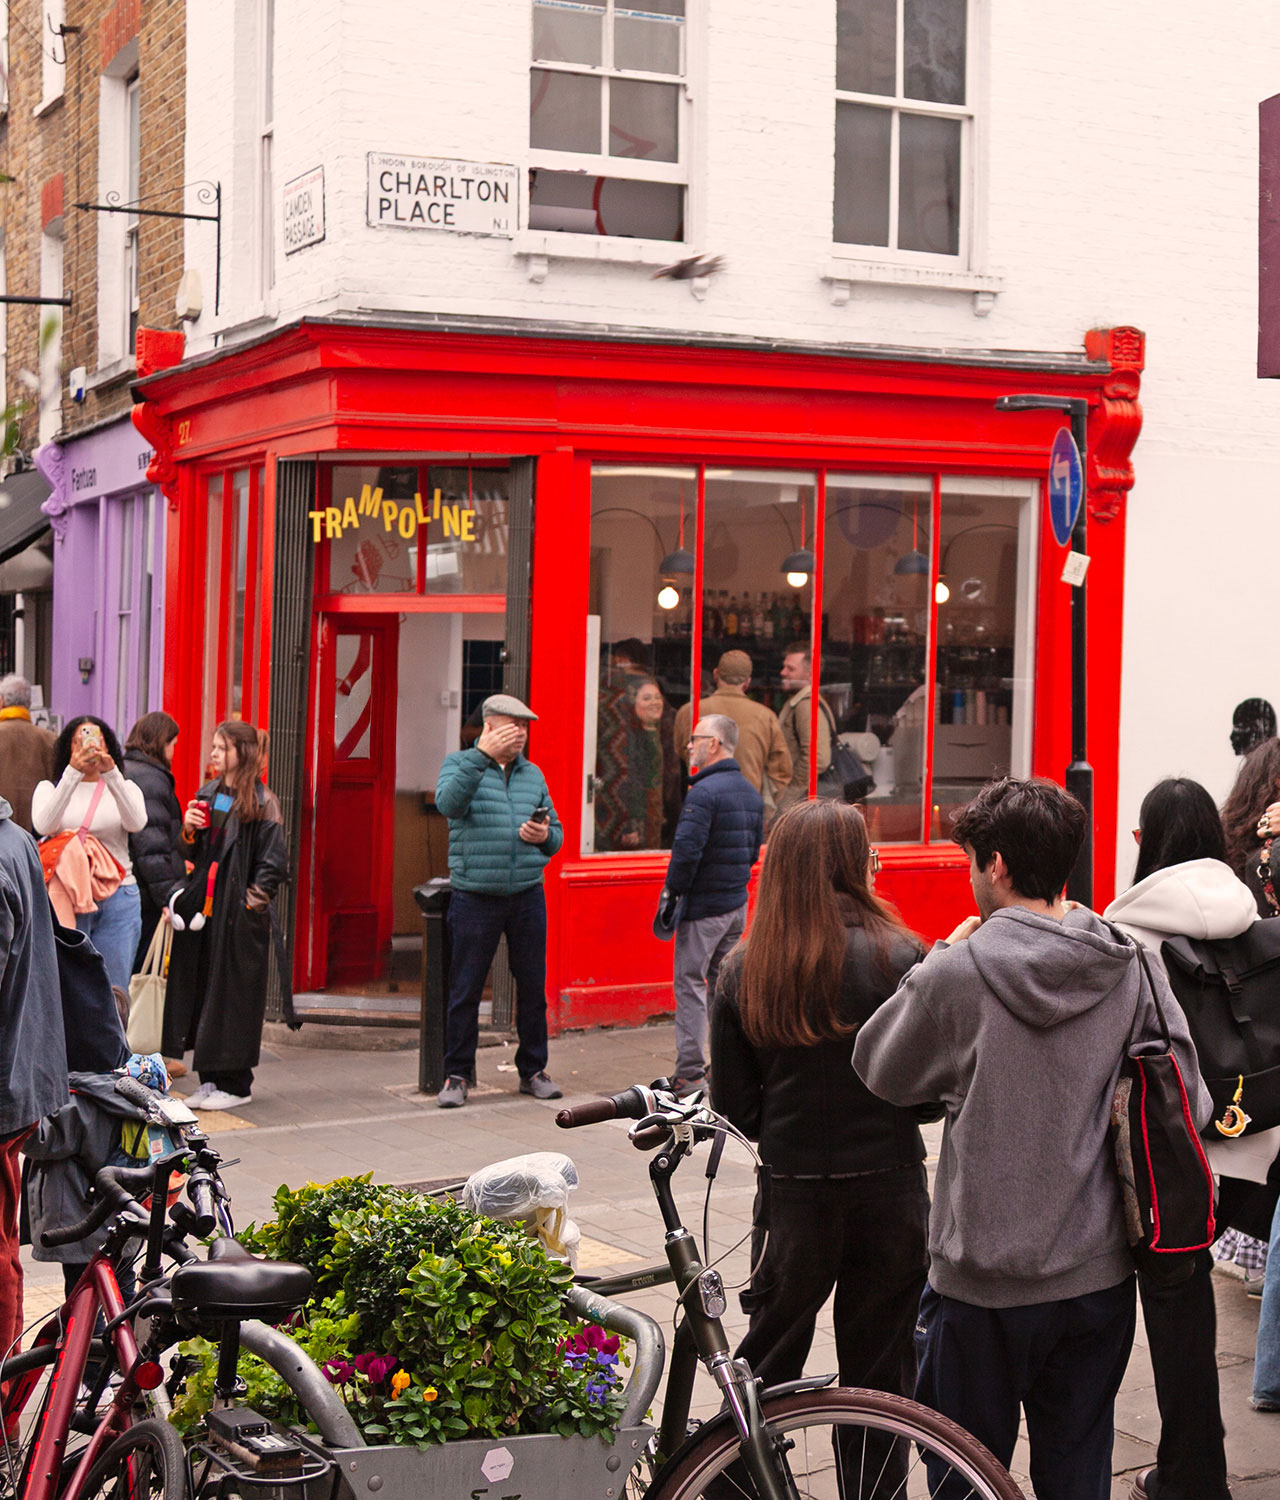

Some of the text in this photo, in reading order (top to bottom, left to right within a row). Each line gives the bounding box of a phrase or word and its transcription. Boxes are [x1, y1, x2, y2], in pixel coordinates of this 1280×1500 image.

[380, 171, 509, 203] CHARLTON
[379, 197, 456, 226] PLACE
[308, 483, 476, 543] TRAMPOLINE
